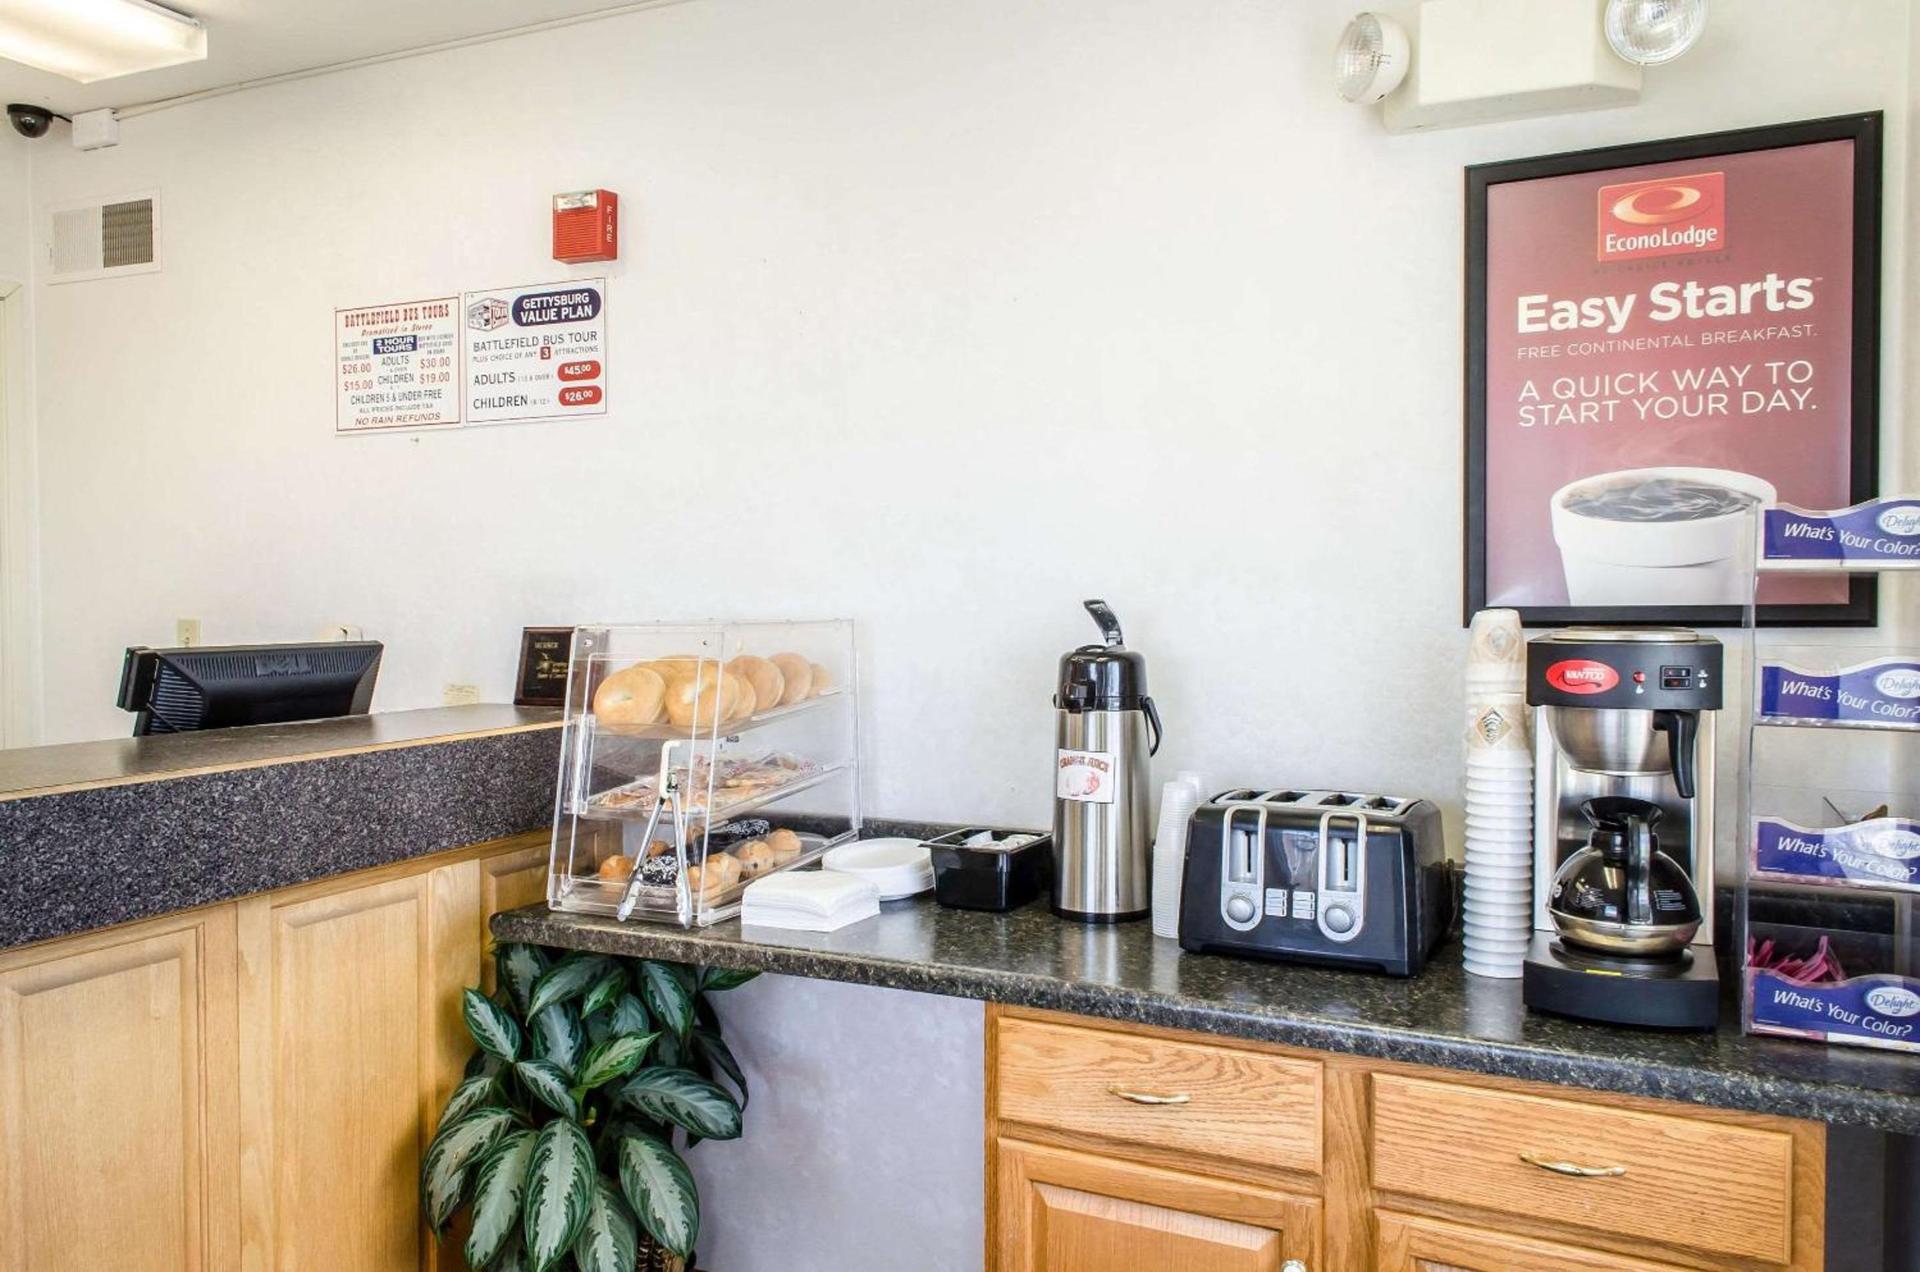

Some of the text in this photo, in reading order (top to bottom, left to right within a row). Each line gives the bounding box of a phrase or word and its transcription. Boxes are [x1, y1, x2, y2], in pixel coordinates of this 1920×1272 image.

[1606, 225, 1719, 253] EconoLodge
[522, 292, 590, 310] GETTYSBURG
[1517, 273, 1814, 334] Easy Starts
[345, 303, 449, 328] BATTLEFIELD BUS TOURS
[520, 304, 593, 324] VALUE PLAN
[411, 323, 433, 332] Stereo
[378, 344, 413, 353] TOURS
[385, 336, 414, 346] HOUR
[473, 330, 598, 353] BATTLEFIELD BUS TOUR
[1517, 324, 1818, 360] FREE CONTINENTAL BREAKFAST.
[381, 355, 410, 367] ADULTS
[490, 353, 513, 362] CHOICE
[514, 351, 523, 360] OF
[524, 350, 537, 359] ANY
[542, 348, 550, 359] 3
[554, 345, 599, 356] ATTRACTIONS
[342, 362, 372, 375] $26.00
[420, 357, 451, 369] $30.00
[564, 364, 592, 376] $45.00
[344, 379, 373, 391] $15.00
[377, 373, 414, 385] CHILDREN
[420, 372, 450, 384] $19.00
[474, 371, 516, 386] ADULTS
[1518, 360, 1813, 402] A QUICK WAY TO
[351, 394, 384, 405] CHILDREN
[398, 390, 422, 402] UNDER
[424, 389, 443, 400] FREE
[473, 395, 528, 410] CHILDREN
[565, 390, 594, 402] $26.00
[1518, 386, 1817, 427] START YOUR DAY.
[355, 412, 441, 426] NO RAIN REFUNDS
[1783, 522, 1835, 541] What's
[1838, 529, 1870, 549] Your
[1781, 680, 1920, 718] What's Your Color?
[1777, 836, 1917, 882] What's Your Color?
[1871, 992, 1915, 1014] Delight
[1773, 989, 1913, 1037] What's Your Color?
